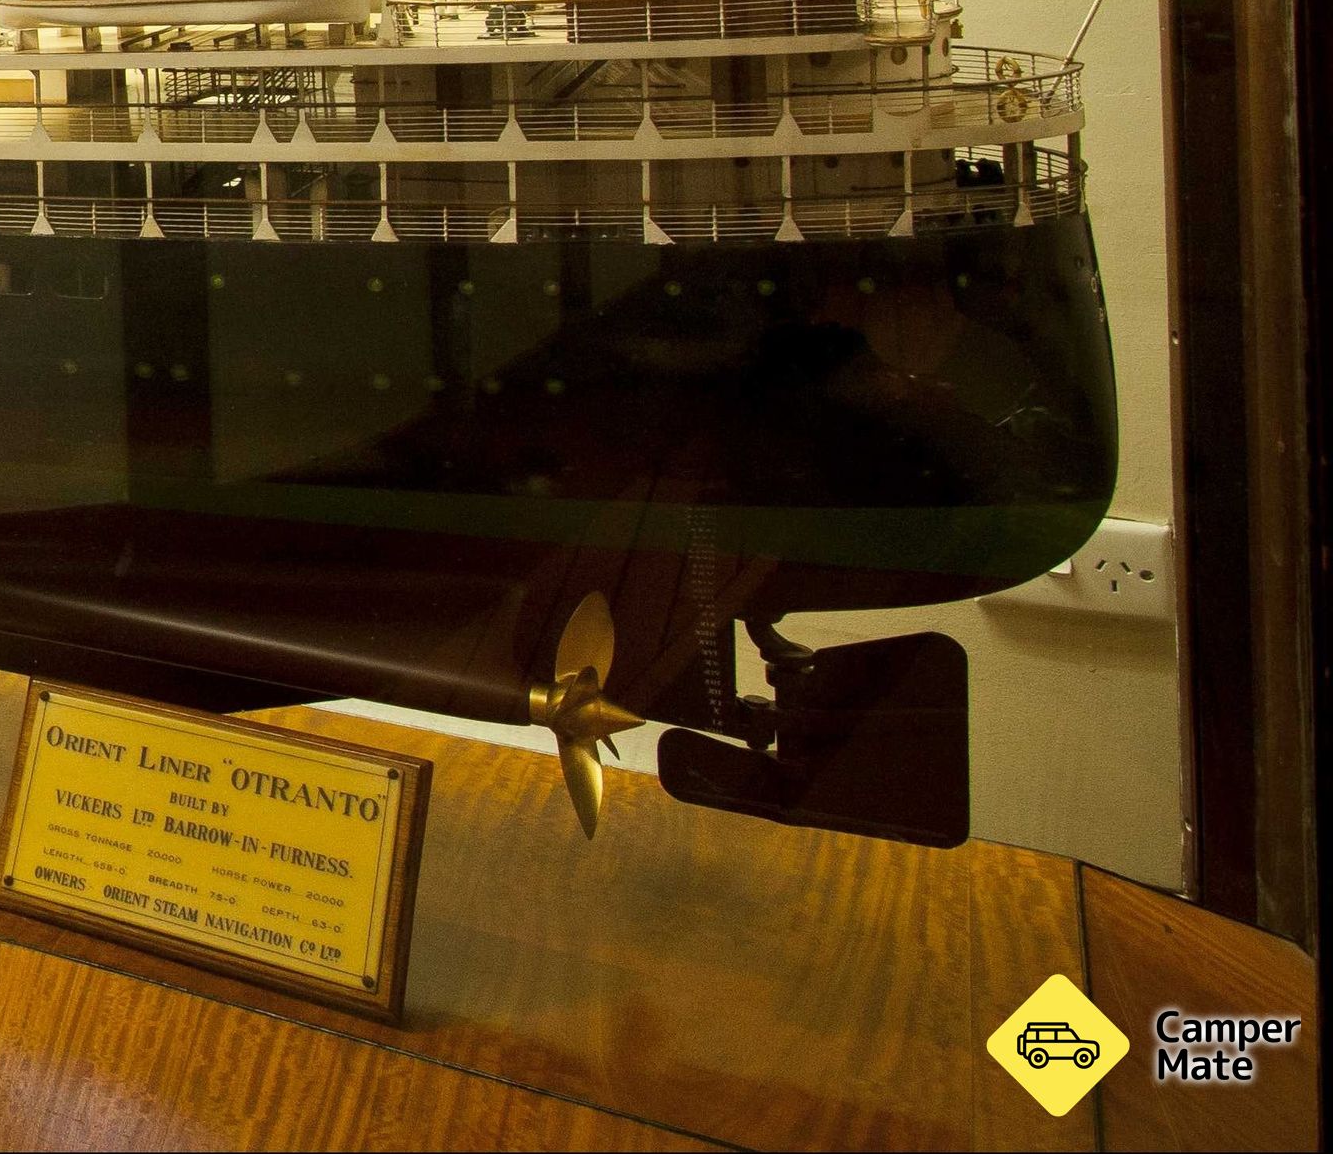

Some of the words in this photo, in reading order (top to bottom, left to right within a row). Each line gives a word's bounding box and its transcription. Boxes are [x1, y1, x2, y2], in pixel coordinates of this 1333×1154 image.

[46, 725, 126, 763] ORIENT
[138, 746, 212, 784] LINER
[223, 757, 386, 822] "OTRANTO"
[55, 788, 123, 820] VICKERS
[169, 791, 208, 812] BUILT
[210, 801, 230, 817] BY
[43, 846, 84, 864] LENGTH
[148, 874, 198, 894] BREADTH
[261, 905, 300, 922] DEPTH
[47, 823, 81, 839] GROSS
[85, 833, 133, 852] TONNAGE
[211, 865, 247, 882] HORSE
[252, 876, 292, 893] POWER
[34, 865, 87, 892] OWNERS
[102, 884, 150, 909] ORIENT
[153, 897, 199, 923] STEAM
[204, 912, 293, 949] NAVIGATION
